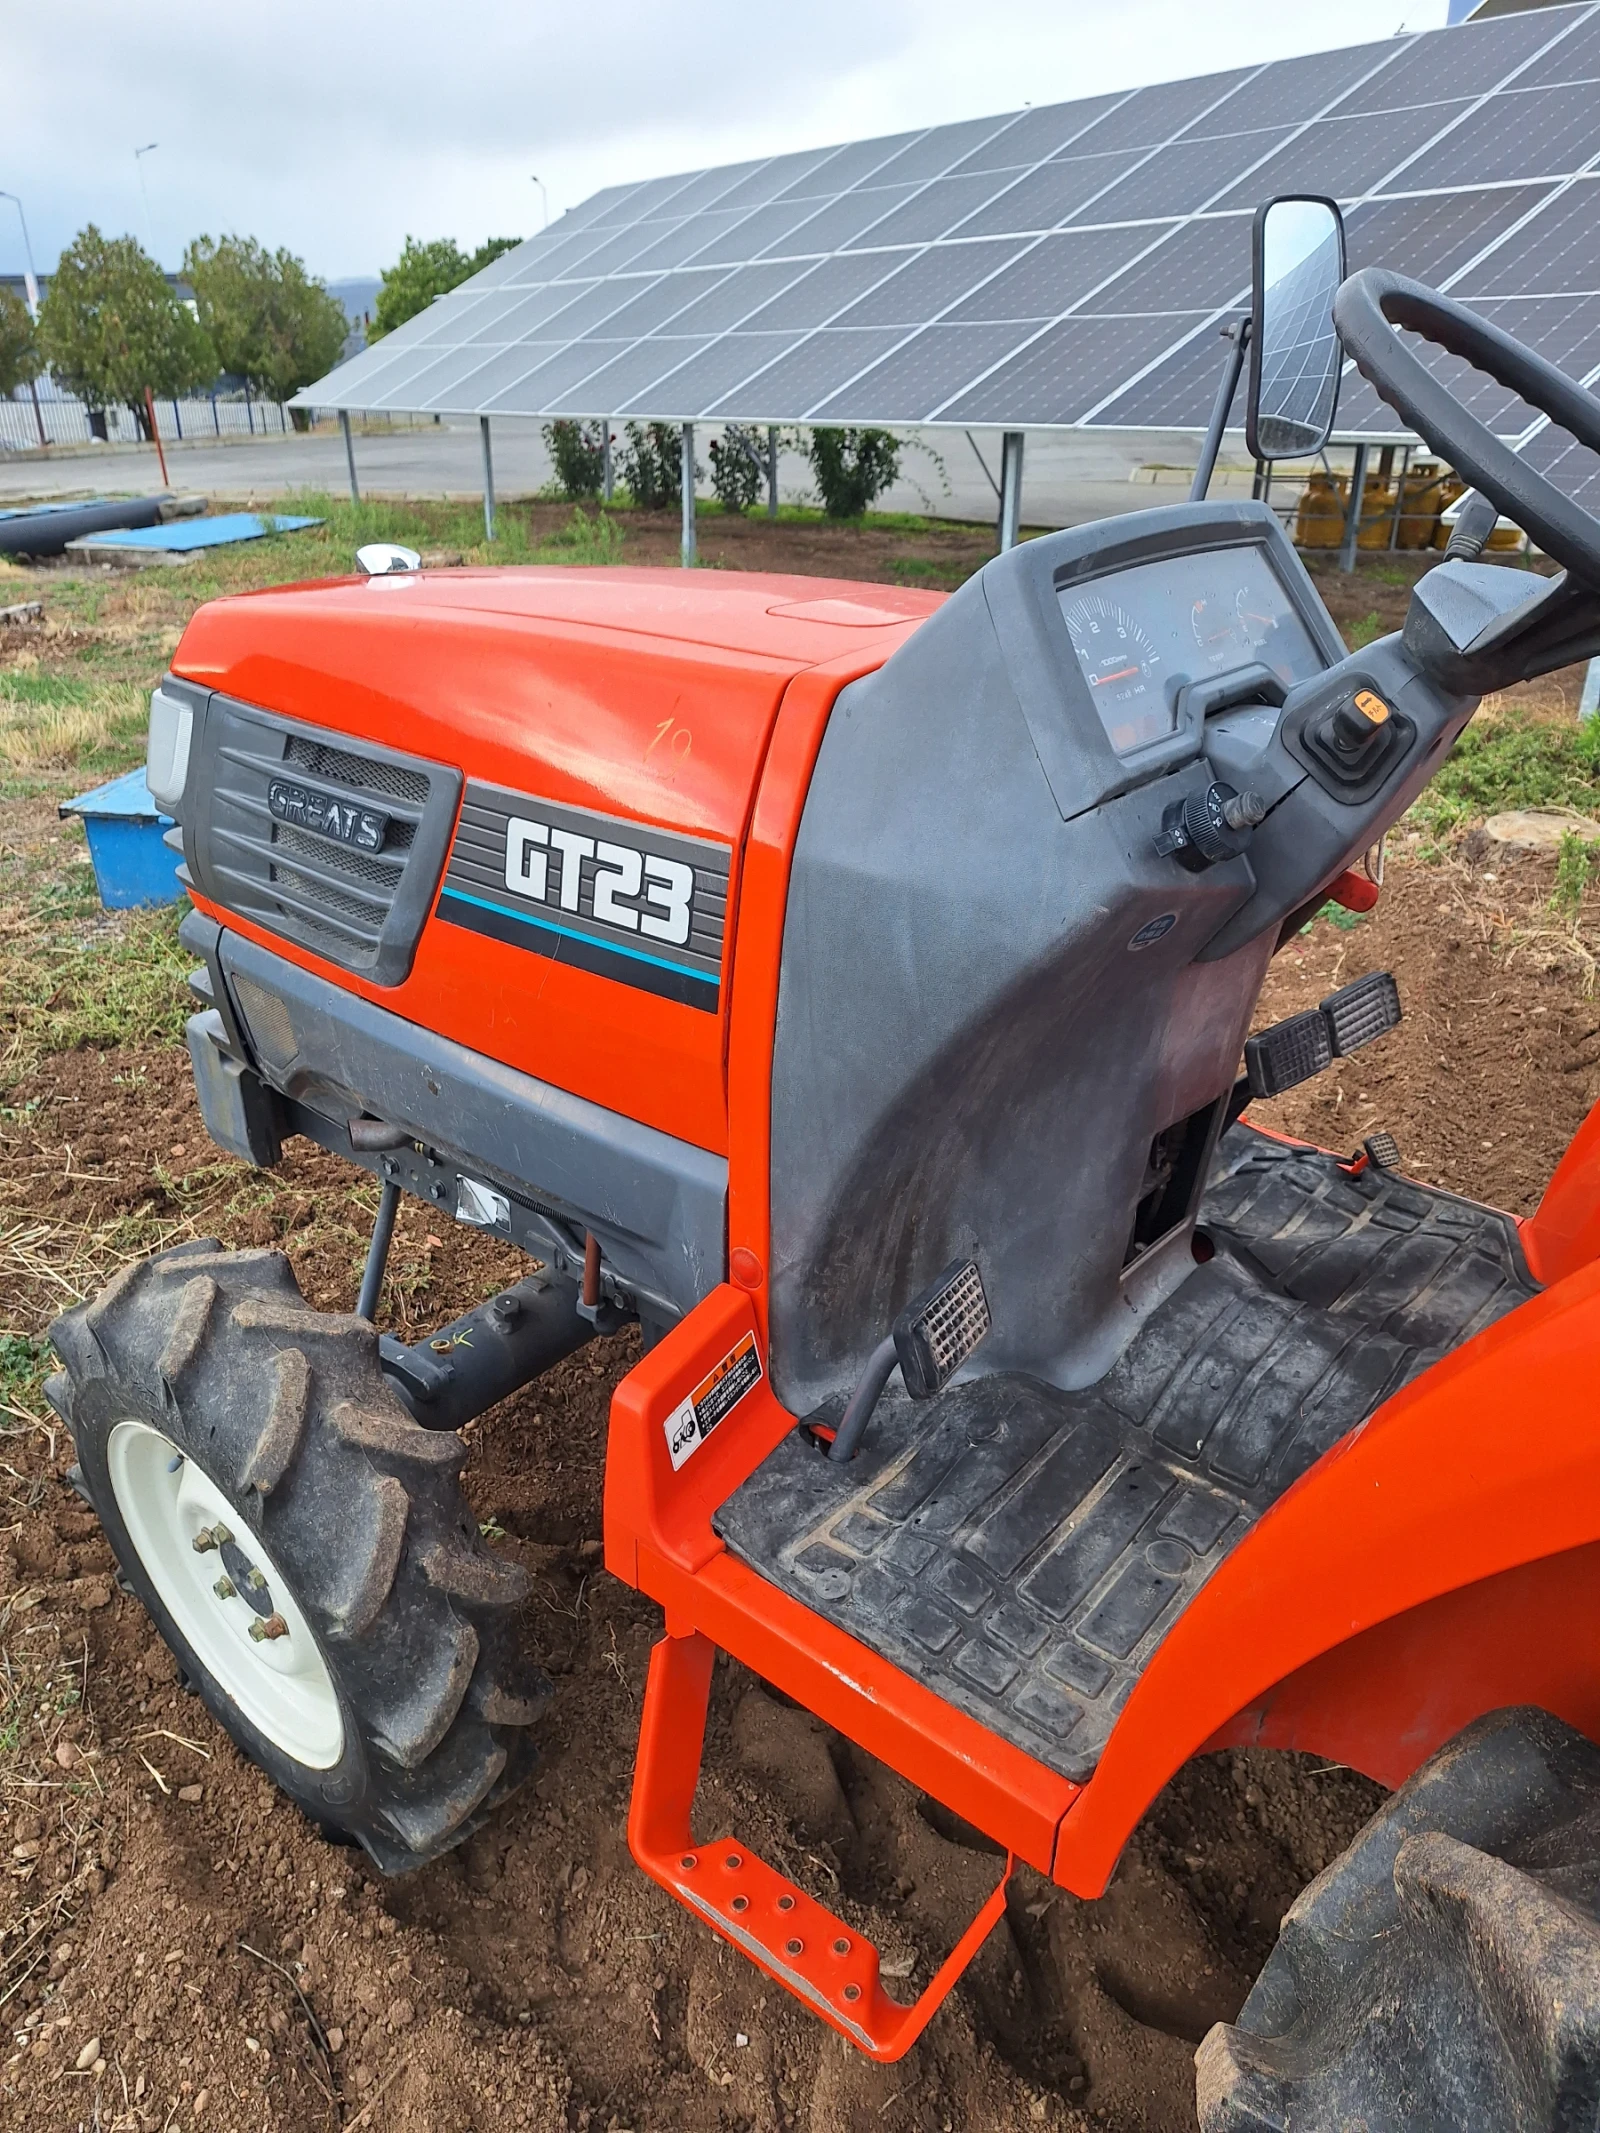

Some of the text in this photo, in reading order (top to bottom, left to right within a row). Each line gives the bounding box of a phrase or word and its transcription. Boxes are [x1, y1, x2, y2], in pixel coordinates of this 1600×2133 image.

[1089, 621, 1101, 634] 2
[1116, 626, 1127, 639] 3
[1081, 648, 1090, 660] 1
[1088, 673, 1099, 686] 0
[504, 816, 694, 945] GT23
[429, 1327, 476, 1349] OK
